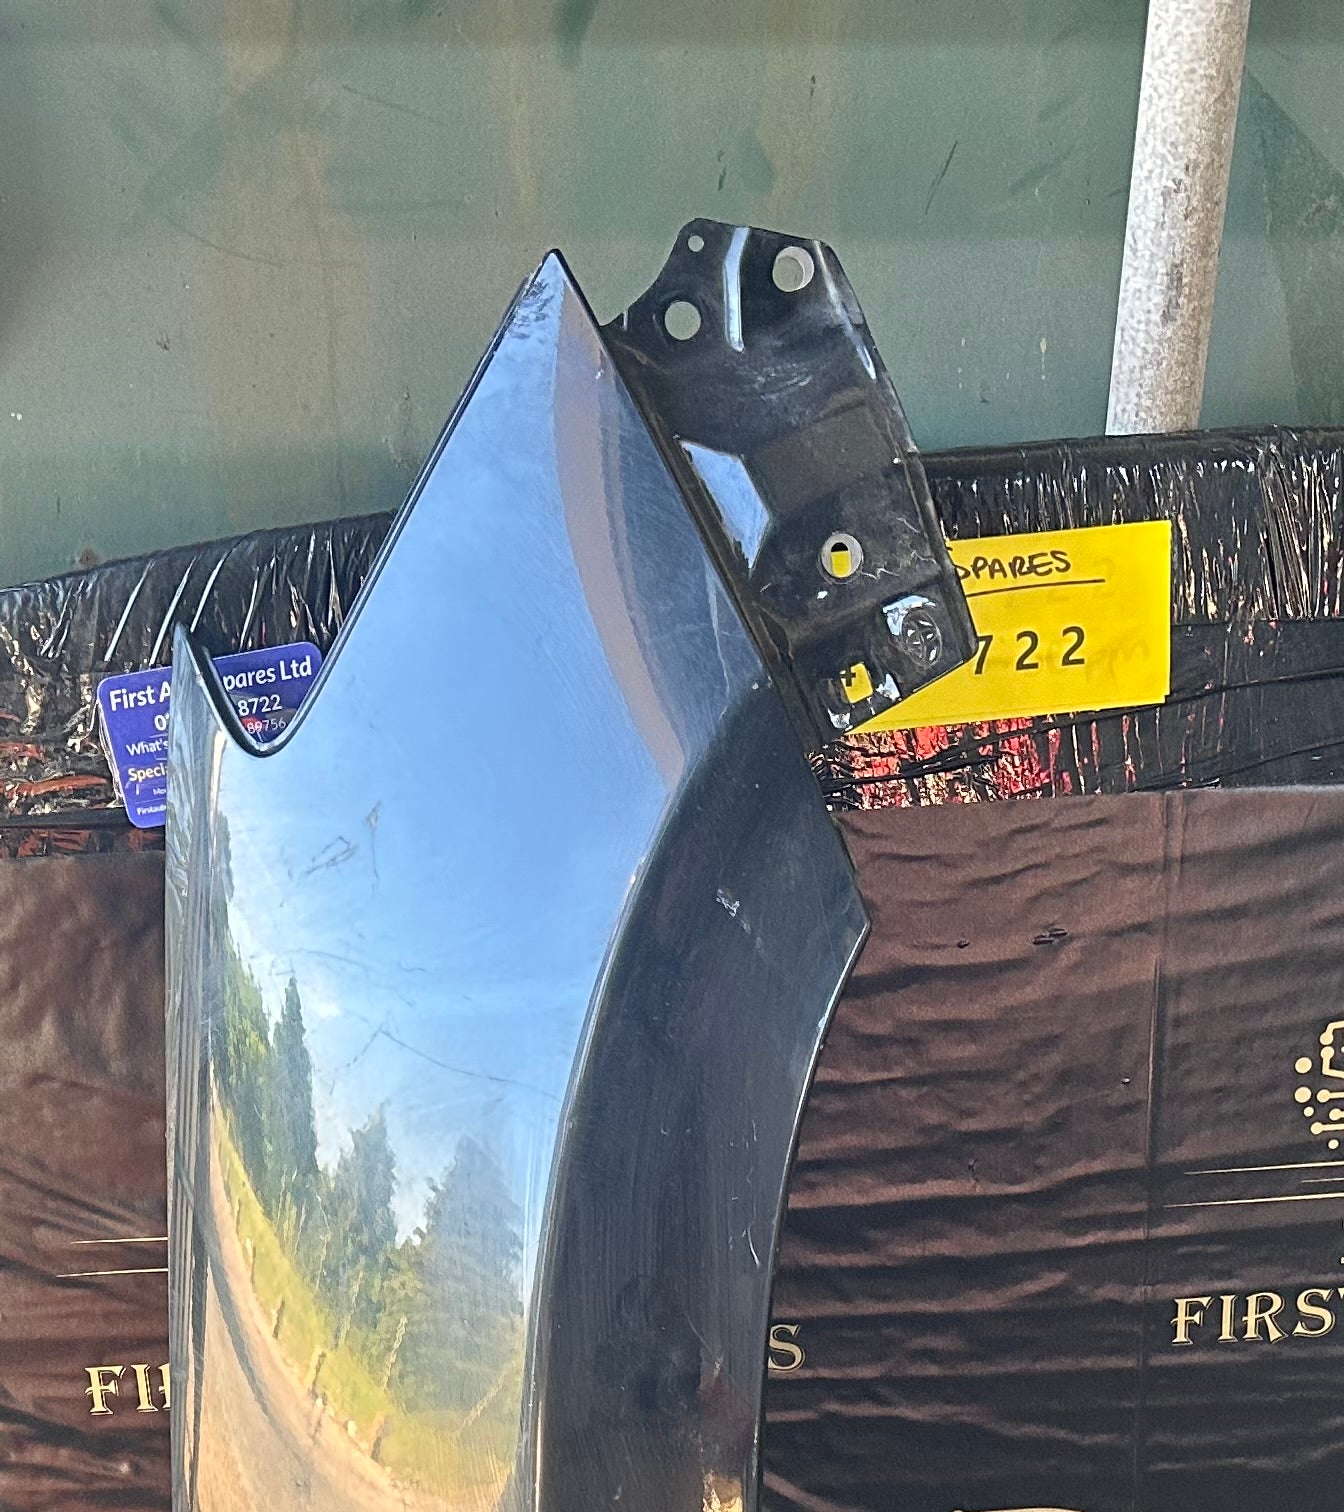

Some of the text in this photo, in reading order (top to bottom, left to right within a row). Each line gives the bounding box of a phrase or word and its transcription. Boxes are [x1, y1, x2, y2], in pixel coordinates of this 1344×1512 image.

[109, 685, 156, 711] First
[222, 667, 276, 692] pares
[279, 655, 312, 680] Ltd
[237, 694, 283, 716] 8722
[246, 717, 287, 735] 89756
[128, 763, 168, 783] Speci
